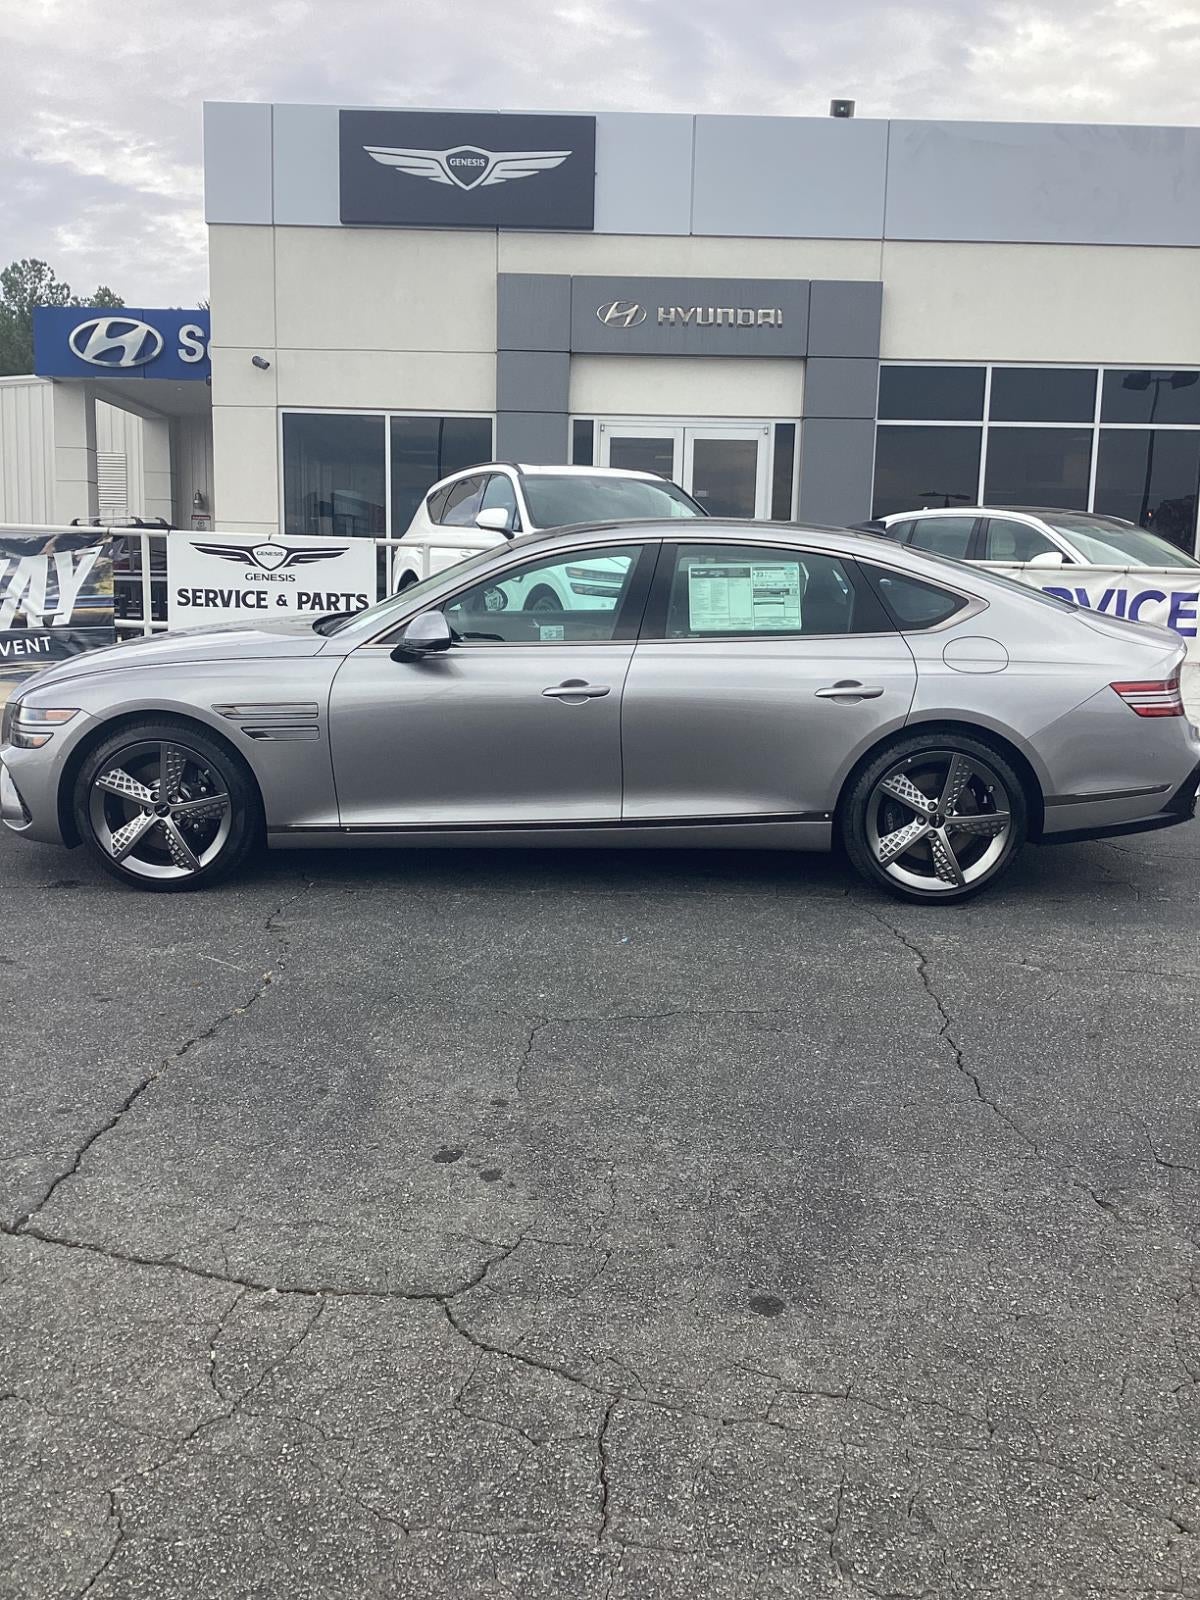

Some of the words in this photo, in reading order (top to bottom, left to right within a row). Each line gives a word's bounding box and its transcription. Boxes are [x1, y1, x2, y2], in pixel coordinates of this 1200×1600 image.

[449, 157, 486, 167] GENESIS
[657, 306, 783, 328] HYUNDAI
[177, 324, 212, 363] S
[0, 545, 104, 631] AY
[245, 572, 296, 582] GENESIS
[176, 588, 268, 609] SERVICE
[276, 594, 289, 607] &
[297, 591, 370, 611] PARTS
